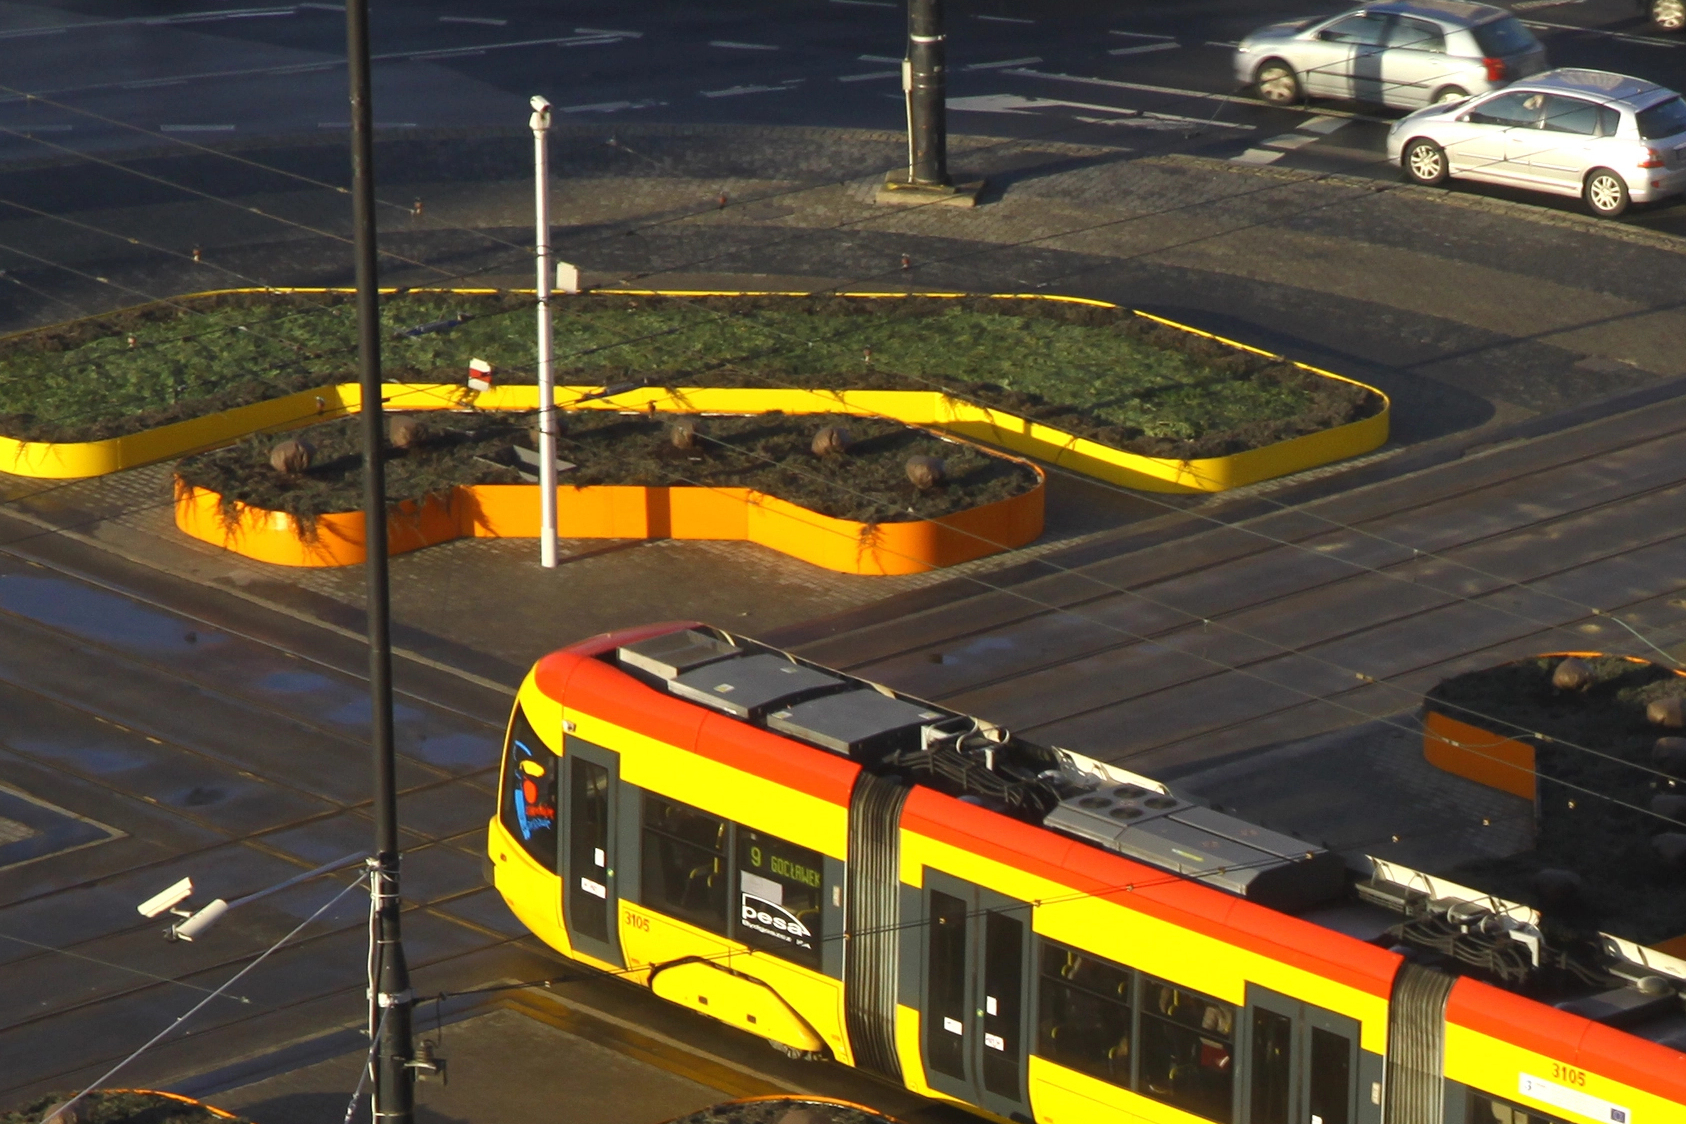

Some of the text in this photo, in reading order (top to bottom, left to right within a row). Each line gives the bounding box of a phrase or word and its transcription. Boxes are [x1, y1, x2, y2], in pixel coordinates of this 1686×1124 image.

[750, 846, 761, 868] 9
[624, 910, 650, 933] 3105
[741, 905, 804, 938] pesa
[1551, 1062, 1587, 1087] 3105
